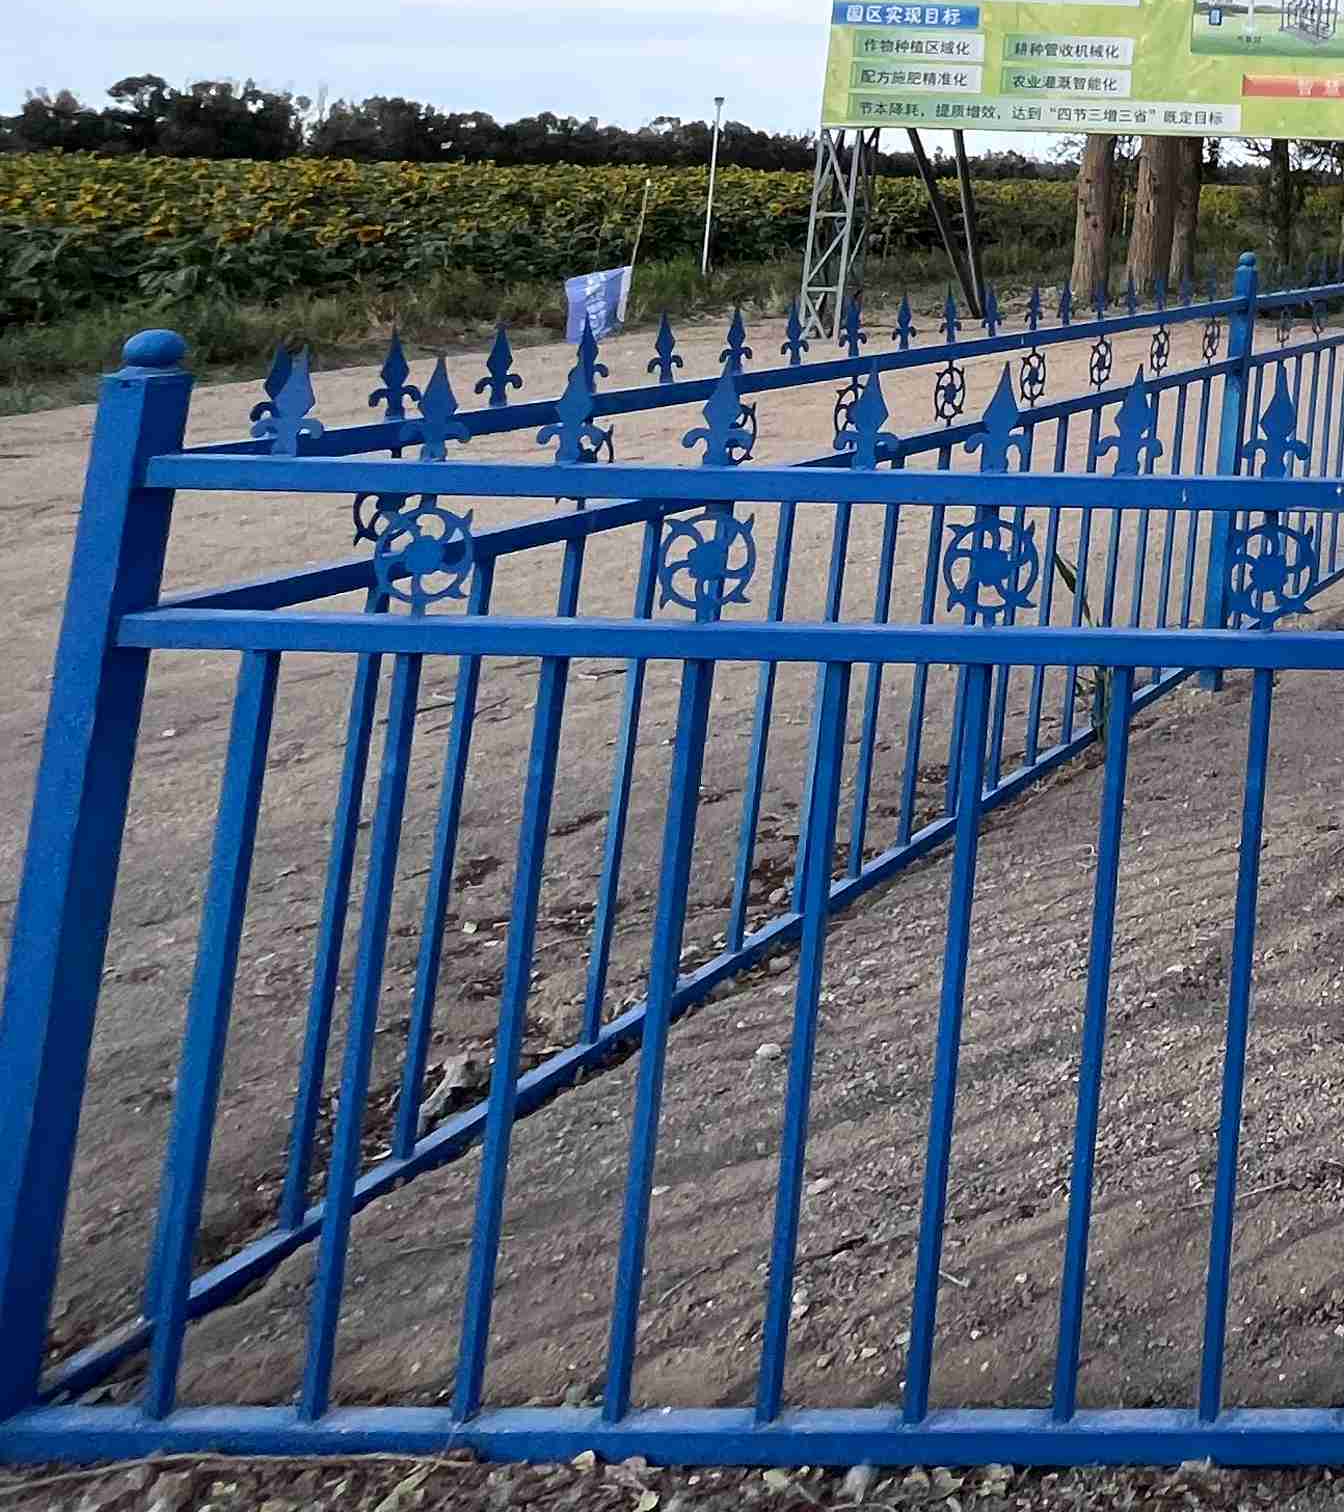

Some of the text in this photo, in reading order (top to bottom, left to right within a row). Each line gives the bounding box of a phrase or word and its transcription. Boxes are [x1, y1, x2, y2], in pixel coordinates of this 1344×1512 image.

[846, 5, 962, 25] 园区实现目标
[863, 38, 971, 56] 作物种植区域化
[859, 69, 969, 87] 配方施肥精准化
